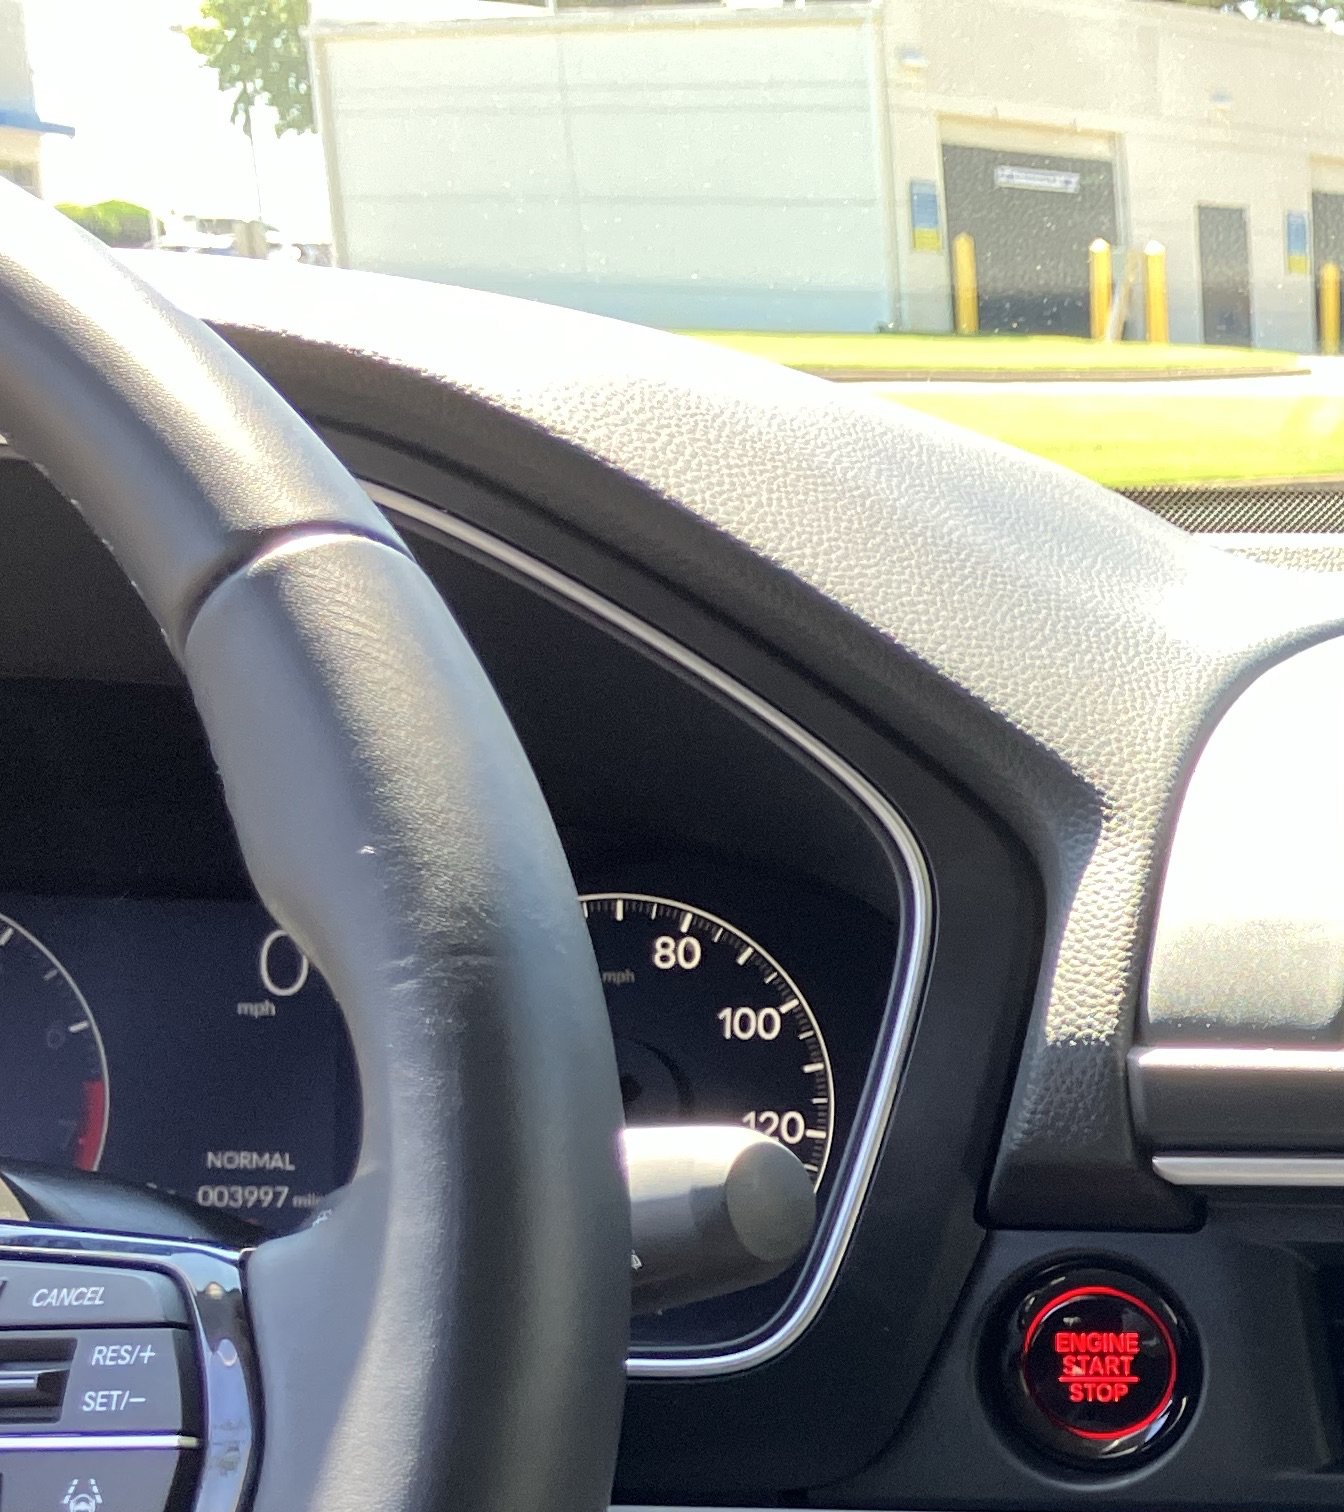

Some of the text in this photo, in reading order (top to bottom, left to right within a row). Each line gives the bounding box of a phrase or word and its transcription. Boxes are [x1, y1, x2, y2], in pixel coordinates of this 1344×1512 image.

[653, 935, 702, 970] 80
[601, 968, 636, 985] mph
[237, 999, 276, 1019] mph
[718, 1006, 782, 1041] 100
[206, 1151, 296, 1171] NORMAL
[196, 1185, 290, 1209] 003997
[31, 1286, 105, 1307] CANCEL
[1055, 1332, 1140, 1353] ENGINE
[91, 1344, 156, 1366] RES/+
[1063, 1355, 1134, 1375] START
[1069, 1382, 1129, 1403] STOP
